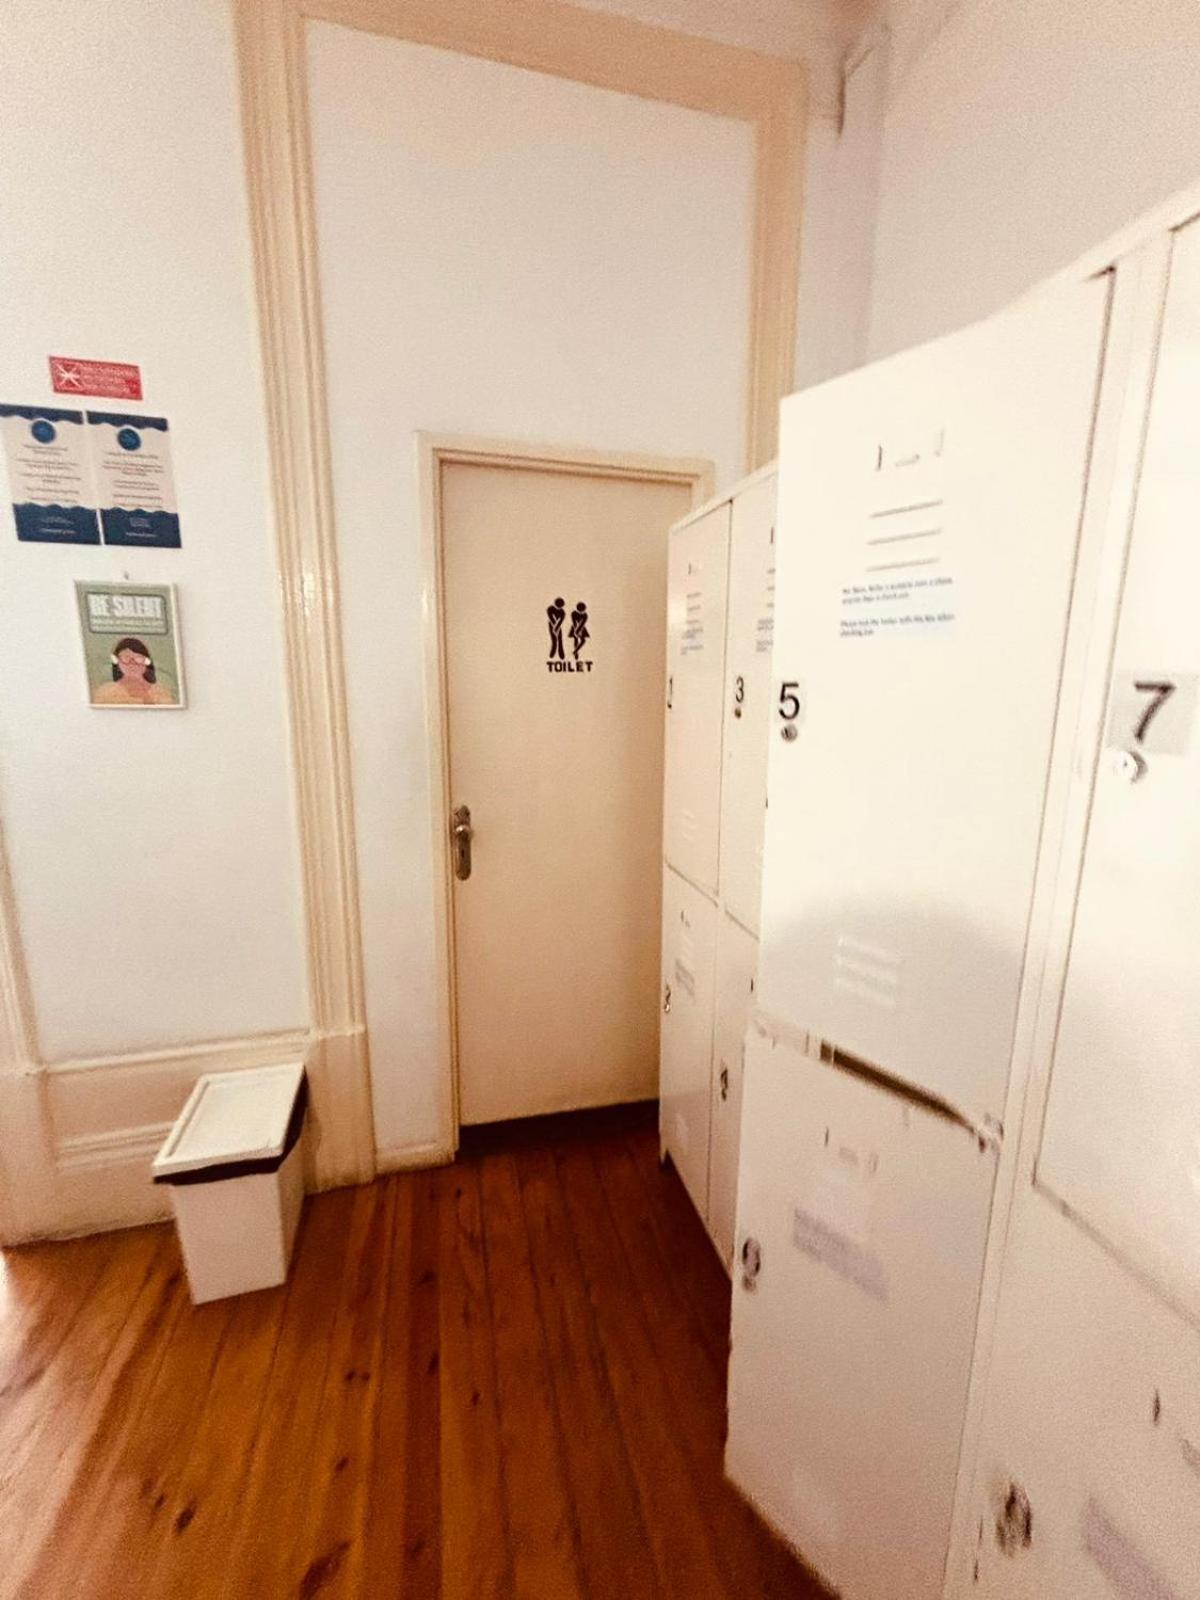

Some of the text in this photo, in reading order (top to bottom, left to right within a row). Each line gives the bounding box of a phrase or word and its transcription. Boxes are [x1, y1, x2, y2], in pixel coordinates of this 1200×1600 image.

[546, 661, 593, 673] TOILET
[735, 676, 745, 703] 3
[779, 682, 800, 720] 5
[1133, 680, 1176, 744] 7
